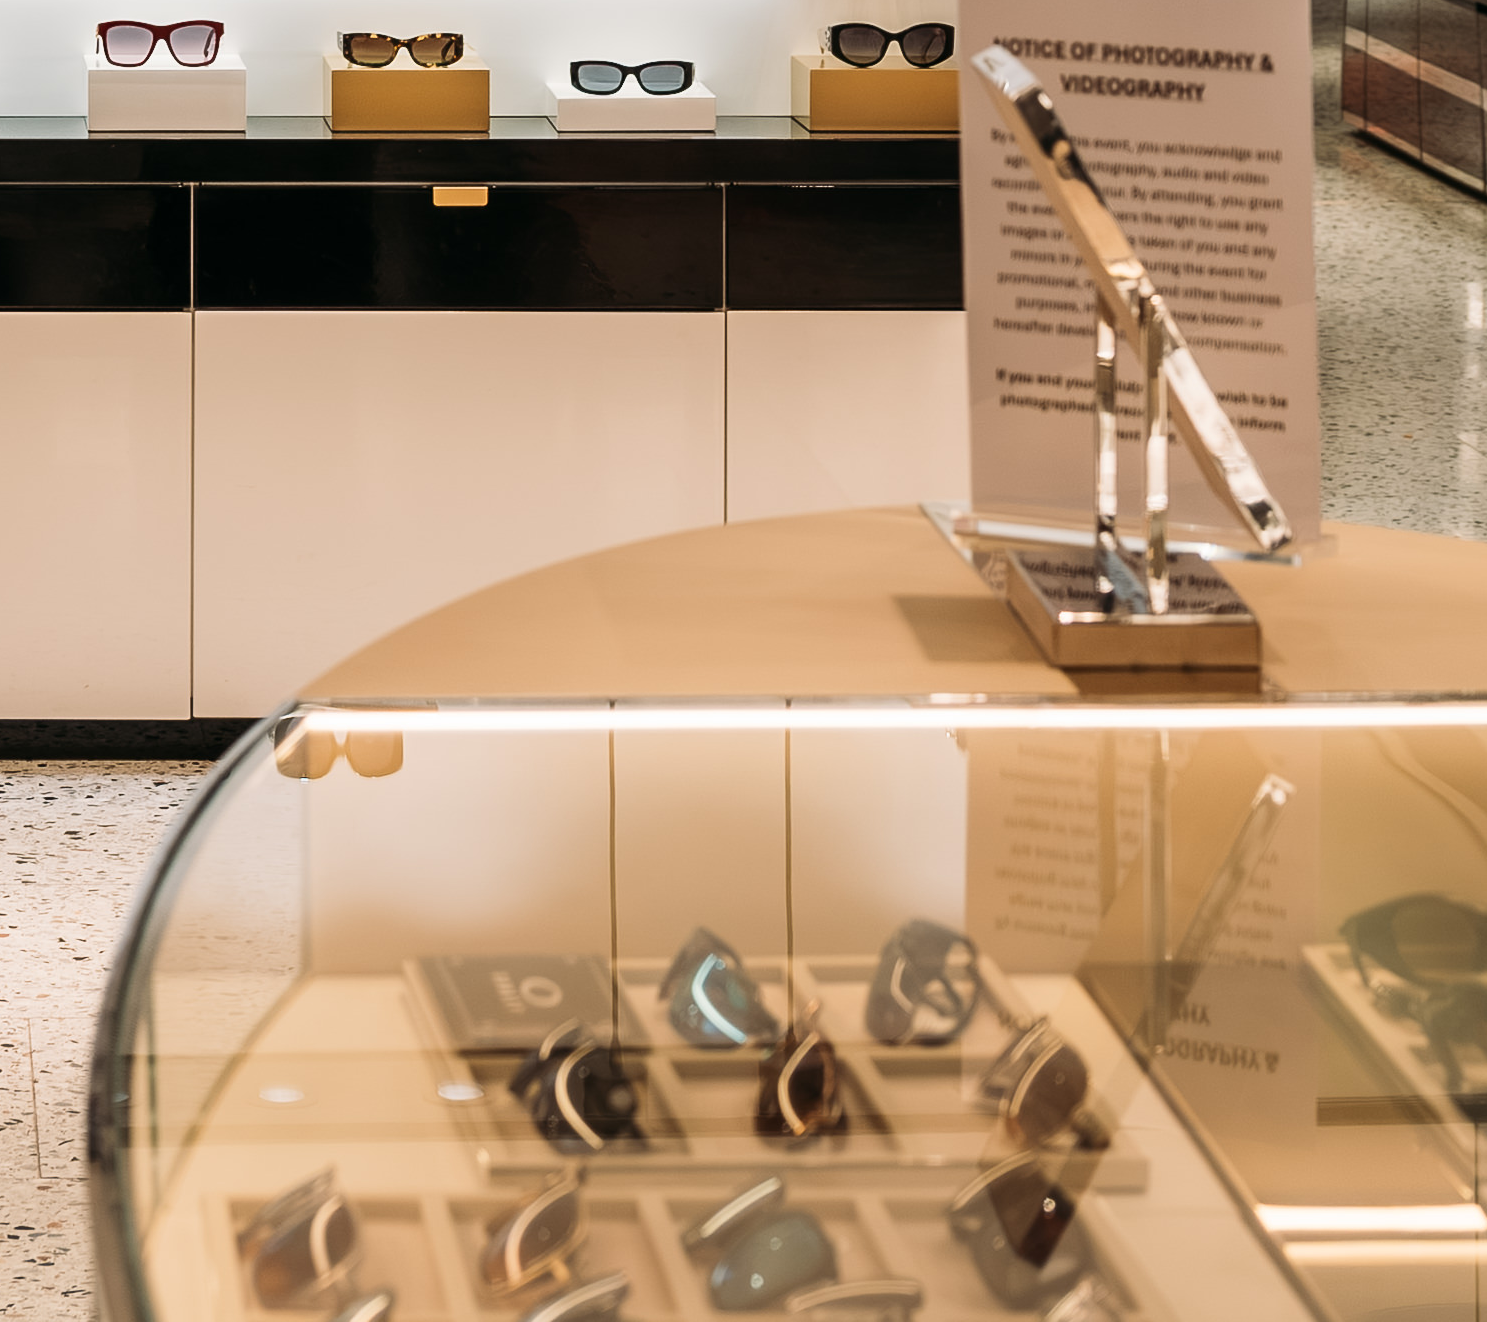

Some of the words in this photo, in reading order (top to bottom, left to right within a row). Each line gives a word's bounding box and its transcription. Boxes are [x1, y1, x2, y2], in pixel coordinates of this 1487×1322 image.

[1069, 41, 1096, 61] OF
[1101, 43, 1254, 72] PHOTOGRAPHY
[1260, 53, 1274, 72] &
[1060, 72, 1205, 101] VIDEOGRAPHY
